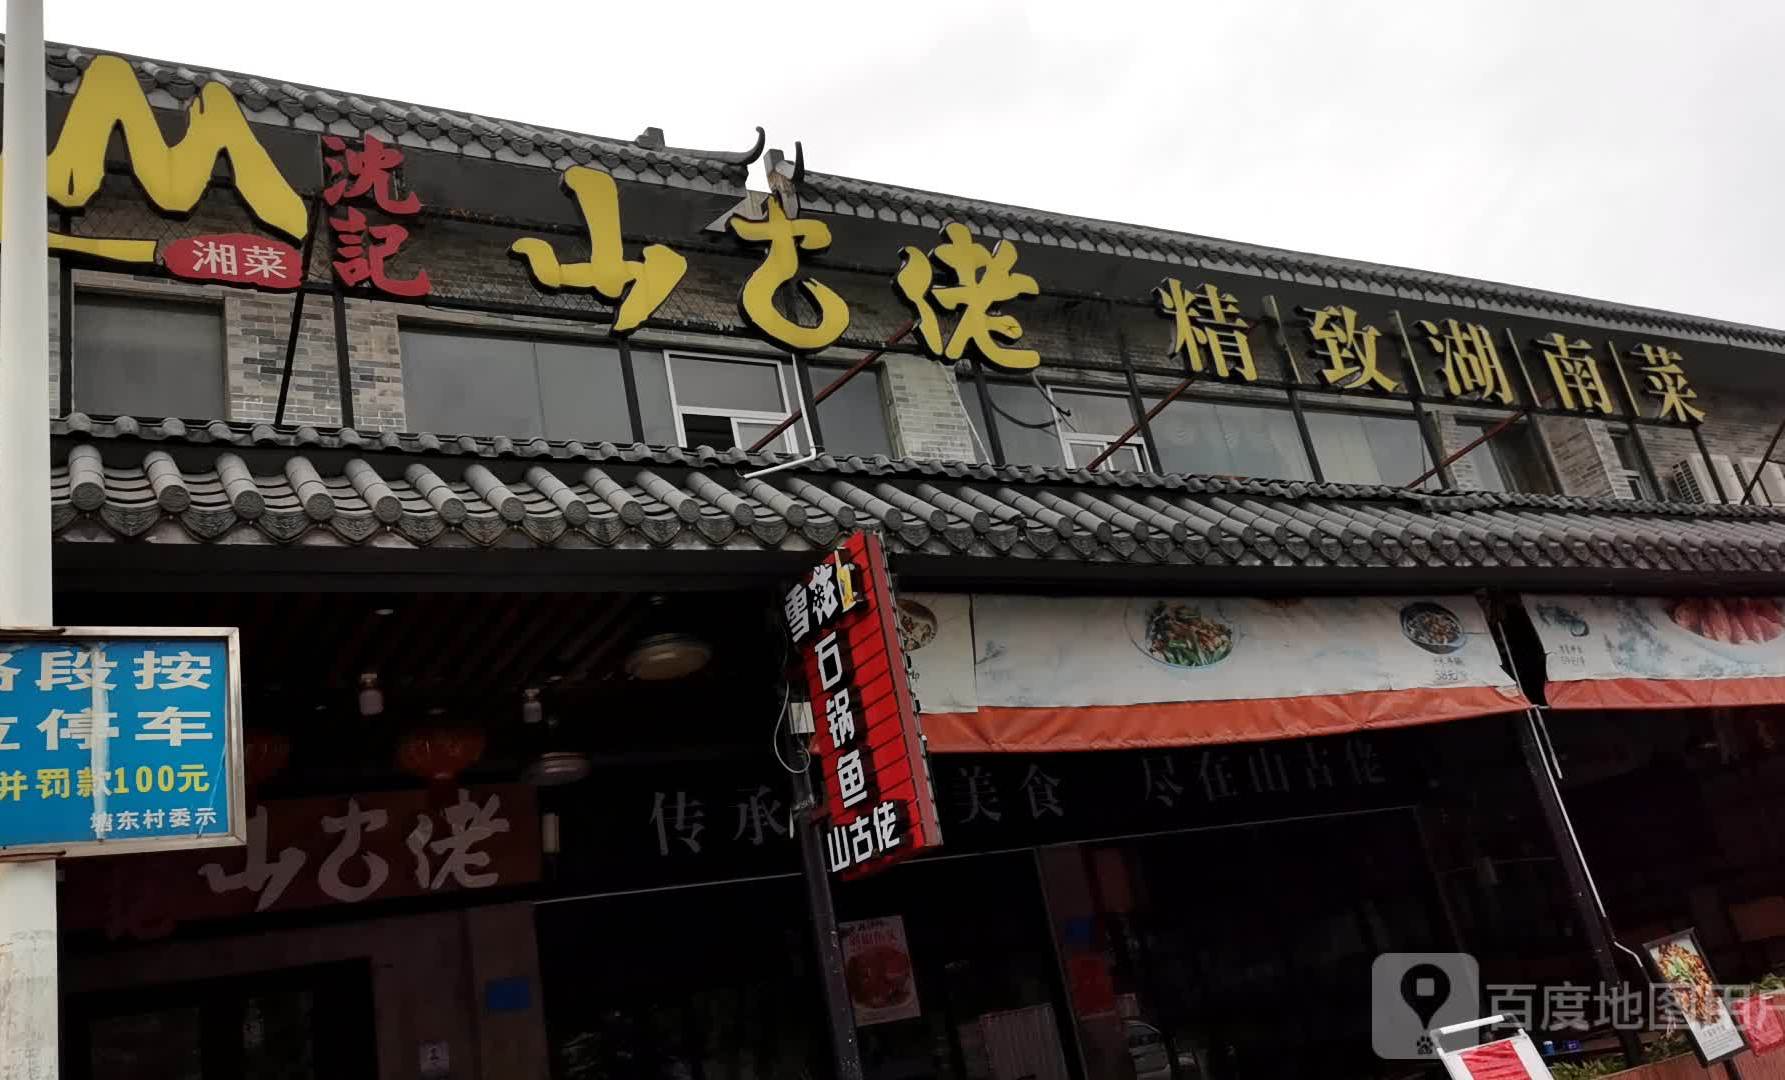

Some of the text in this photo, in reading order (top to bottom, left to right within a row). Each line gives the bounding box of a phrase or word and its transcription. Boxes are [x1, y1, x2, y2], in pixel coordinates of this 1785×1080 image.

[191, 239, 288, 280] 湘菜
[321, 134, 431, 297] 沈記
[508, 165, 1042, 370] 山古佬
[1154, 276, 1705, 423] 精致湖南菜
[784, 563, 840, 644] 雪花
[814, 631, 868, 808] 石锅鱼
[826, 801, 900, 873] 山古佬
[953, 763, 1065, 825] 美食
